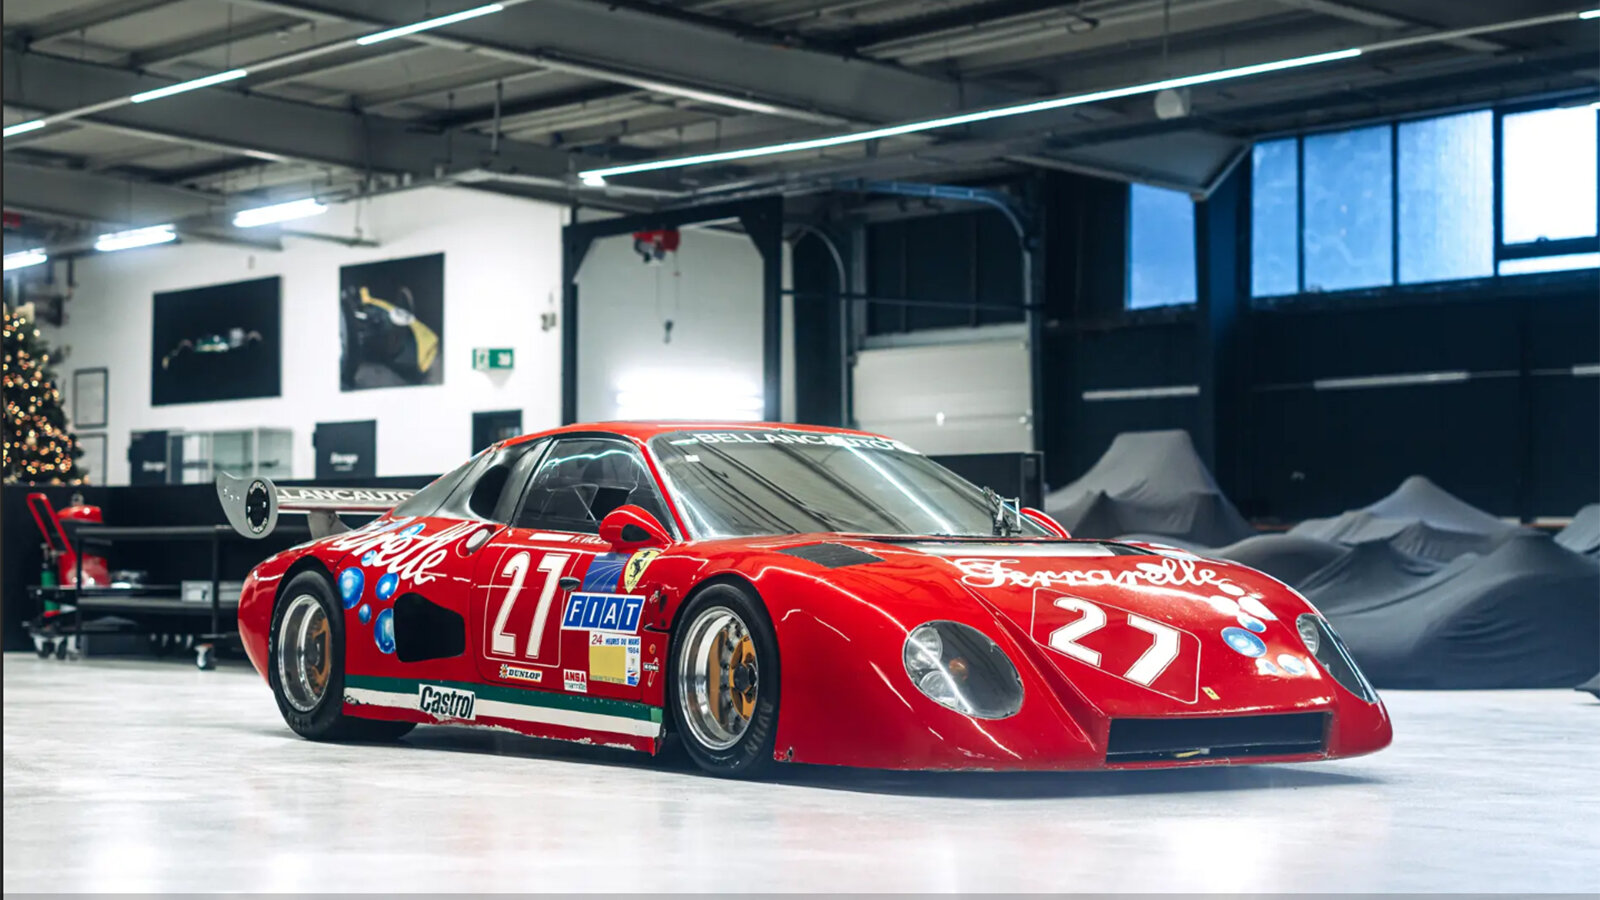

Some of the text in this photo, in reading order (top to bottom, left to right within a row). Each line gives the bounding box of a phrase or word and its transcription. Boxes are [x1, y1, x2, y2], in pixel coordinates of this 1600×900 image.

[953, 558, 1223, 588] Ferrarelle
[491, 551, 571, 660] 27
[568, 600, 640, 627] FIAT
[591, 634, 603, 645] 24
[1048, 597, 1181, 687] 27
[508, 669, 541, 680] DUNLOP
[565, 671, 586, 683] ANSA
[420, 686, 475, 719] Castrol
